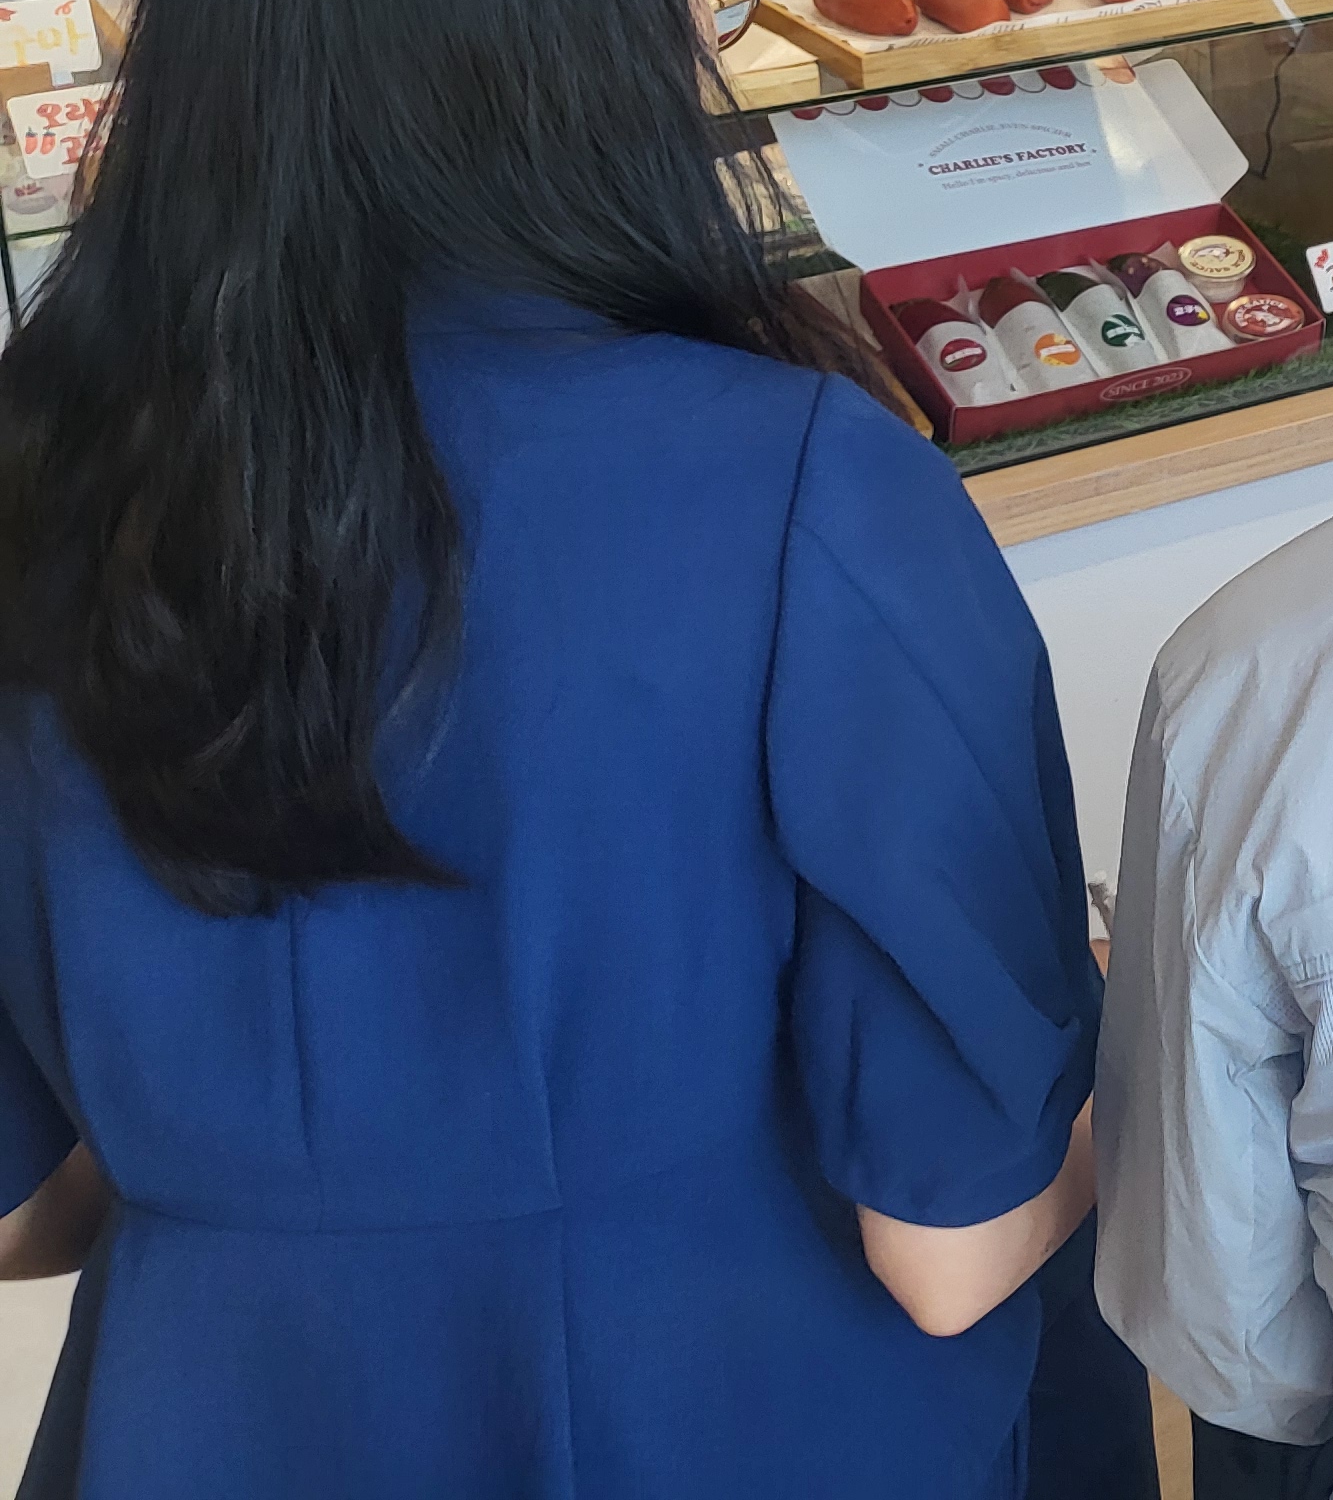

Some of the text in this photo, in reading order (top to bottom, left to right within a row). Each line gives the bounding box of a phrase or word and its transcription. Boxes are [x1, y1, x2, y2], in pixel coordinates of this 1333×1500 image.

[928, 143, 1087, 175] CHARLIE'S FACTORY
[1107, 371, 1187, 396] SINCE 2023
